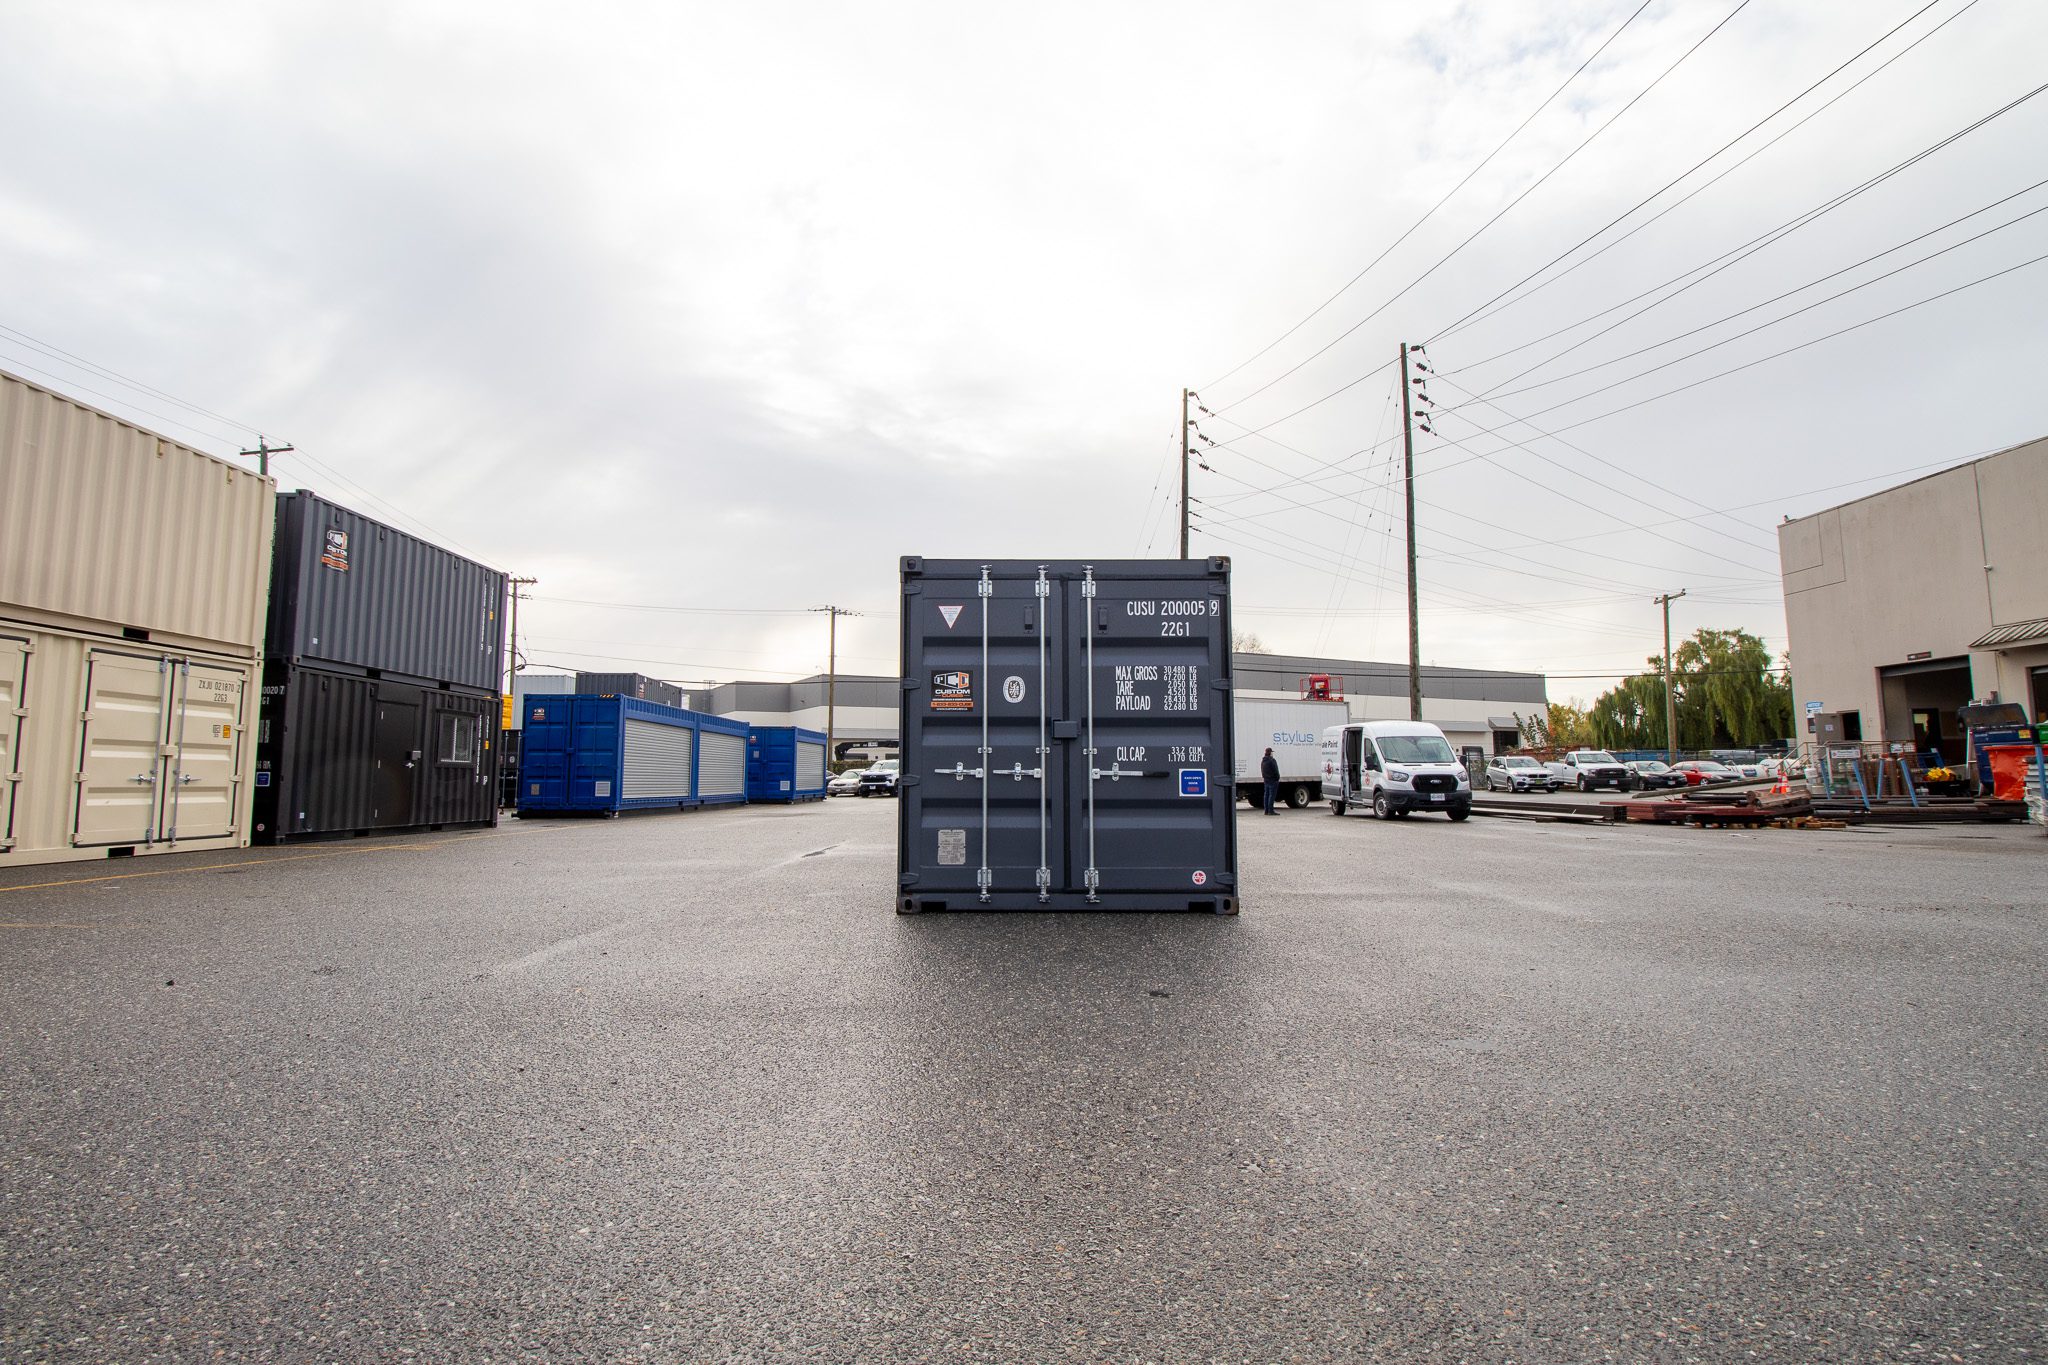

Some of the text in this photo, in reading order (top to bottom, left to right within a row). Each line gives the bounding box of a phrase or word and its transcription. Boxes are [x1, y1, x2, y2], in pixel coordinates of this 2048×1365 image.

[1127, 601, 1218, 616] CUSU 200005 9
[1161, 622, 1190, 636] 22G1
[1115, 666, 1132, 680] MAX
[1134, 666, 1158, 680] GROSS
[1116, 681, 1134, 695] TARE
[1189, 688, 1197, 696] LB
[1116, 696, 1151, 710] PAYLOAD
[1190, 703, 1198, 711] LB
[1272, 731, 1314, 744] stylus
